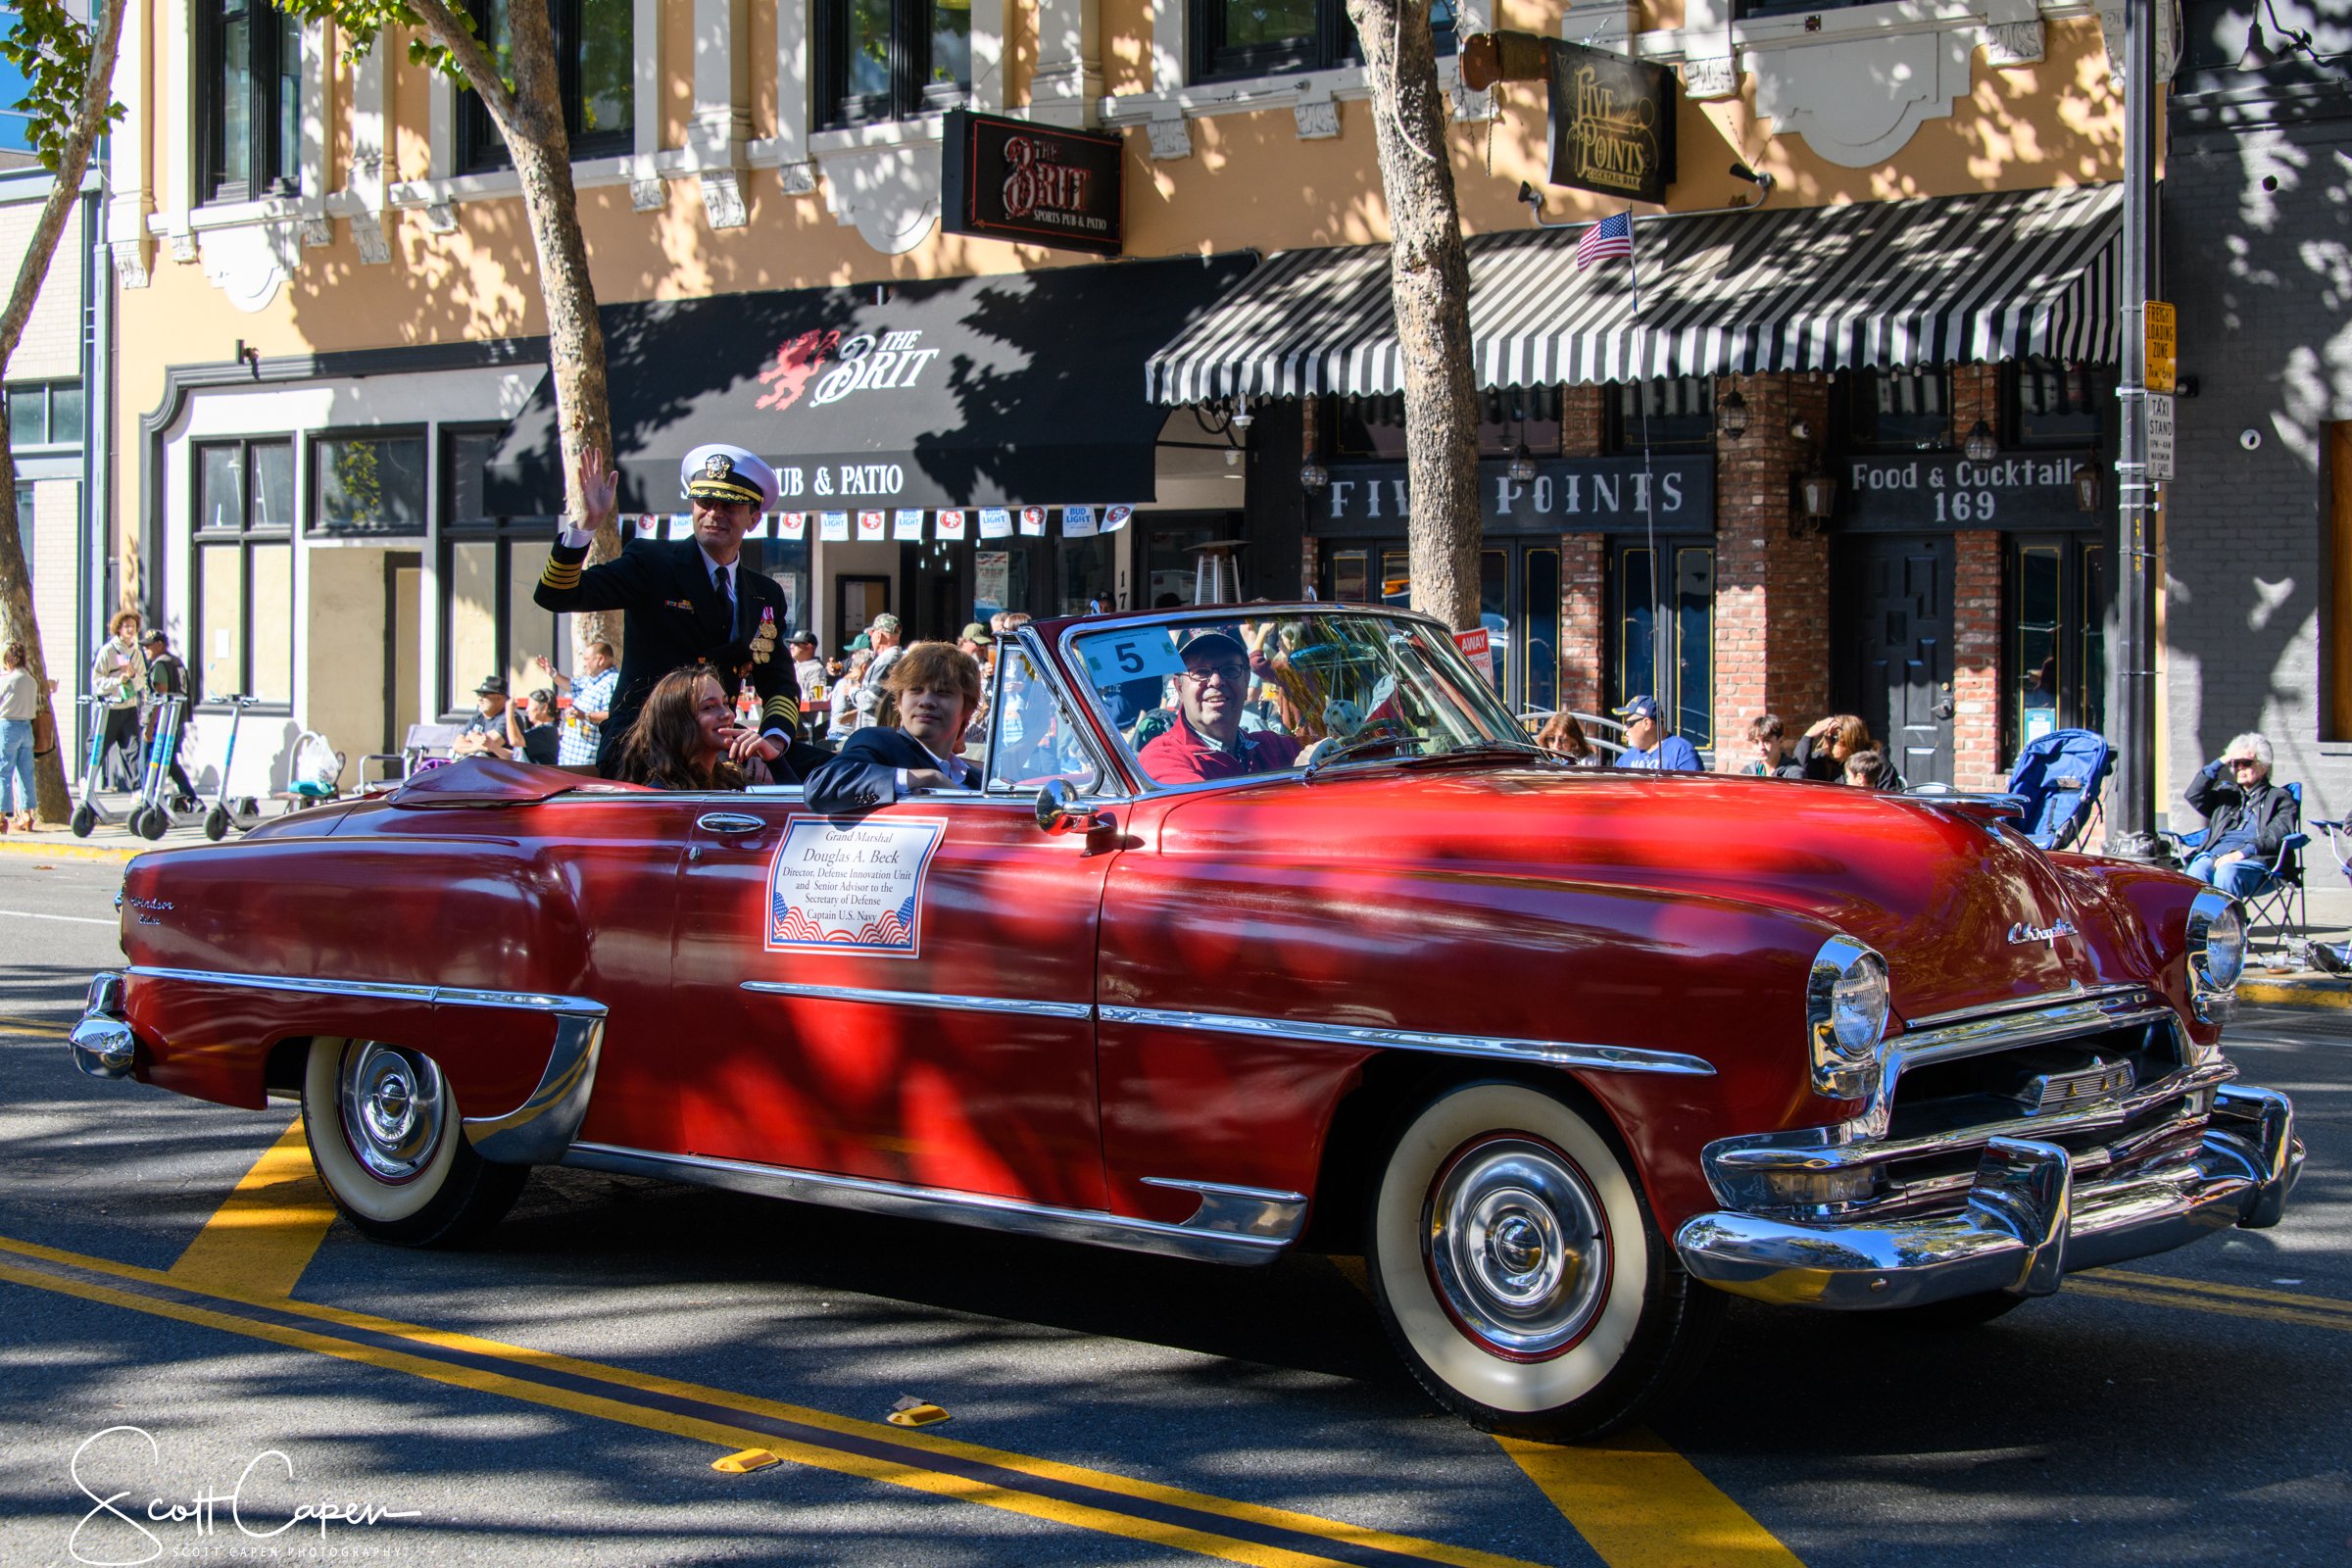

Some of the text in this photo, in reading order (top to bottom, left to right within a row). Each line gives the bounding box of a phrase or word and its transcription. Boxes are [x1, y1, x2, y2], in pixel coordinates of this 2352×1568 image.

[1574, 63, 1614, 121] FIVE
[1576, 118, 1644, 178] POINTS
[1003, 136, 1092, 220] BRIT
[1589, 169, 1639, 186] COCKTAIL BAR
[1033, 209, 1107, 230] SPORTS PUB & PATIO
[2147, 305, 2173, 323] FREIGHT
[879, 329, 923, 352] THE
[2146, 323, 2174, 342] LOADING
[2153, 341, 2169, 359] ZONE
[808, 333, 940, 408] BRIT
[2151, 399, 2170, 417] TAXI
[2148, 419, 2173, 437] STAND
[772, 464, 904, 496] UB & PATIO
[1852, 462, 1918, 490] Food
[1928, 466, 1946, 488] &
[1331, 471, 1683, 518] FIV POINTS
[1069, 507, 1087, 515] BUD
[1934, 491, 1996, 522] 169
[982, 515, 1005, 524] LIGHT
[1065, 514, 1091, 523] LIGHT
[1461, 633, 1486, 653] AWAY
[1114, 642, 1145, 674] 5
[825, 830, 894, 844] Grand Marshal
[803, 848, 901, 867] Douglas A. Beck
[782, 866, 911, 880] Director, Defense Innovation Unit
[795, 879, 894, 893] and Senior Advisor to the
[805, 893, 882, 907] Secretary of Defense
[807, 908, 878, 924] Captain U.S. Navy
